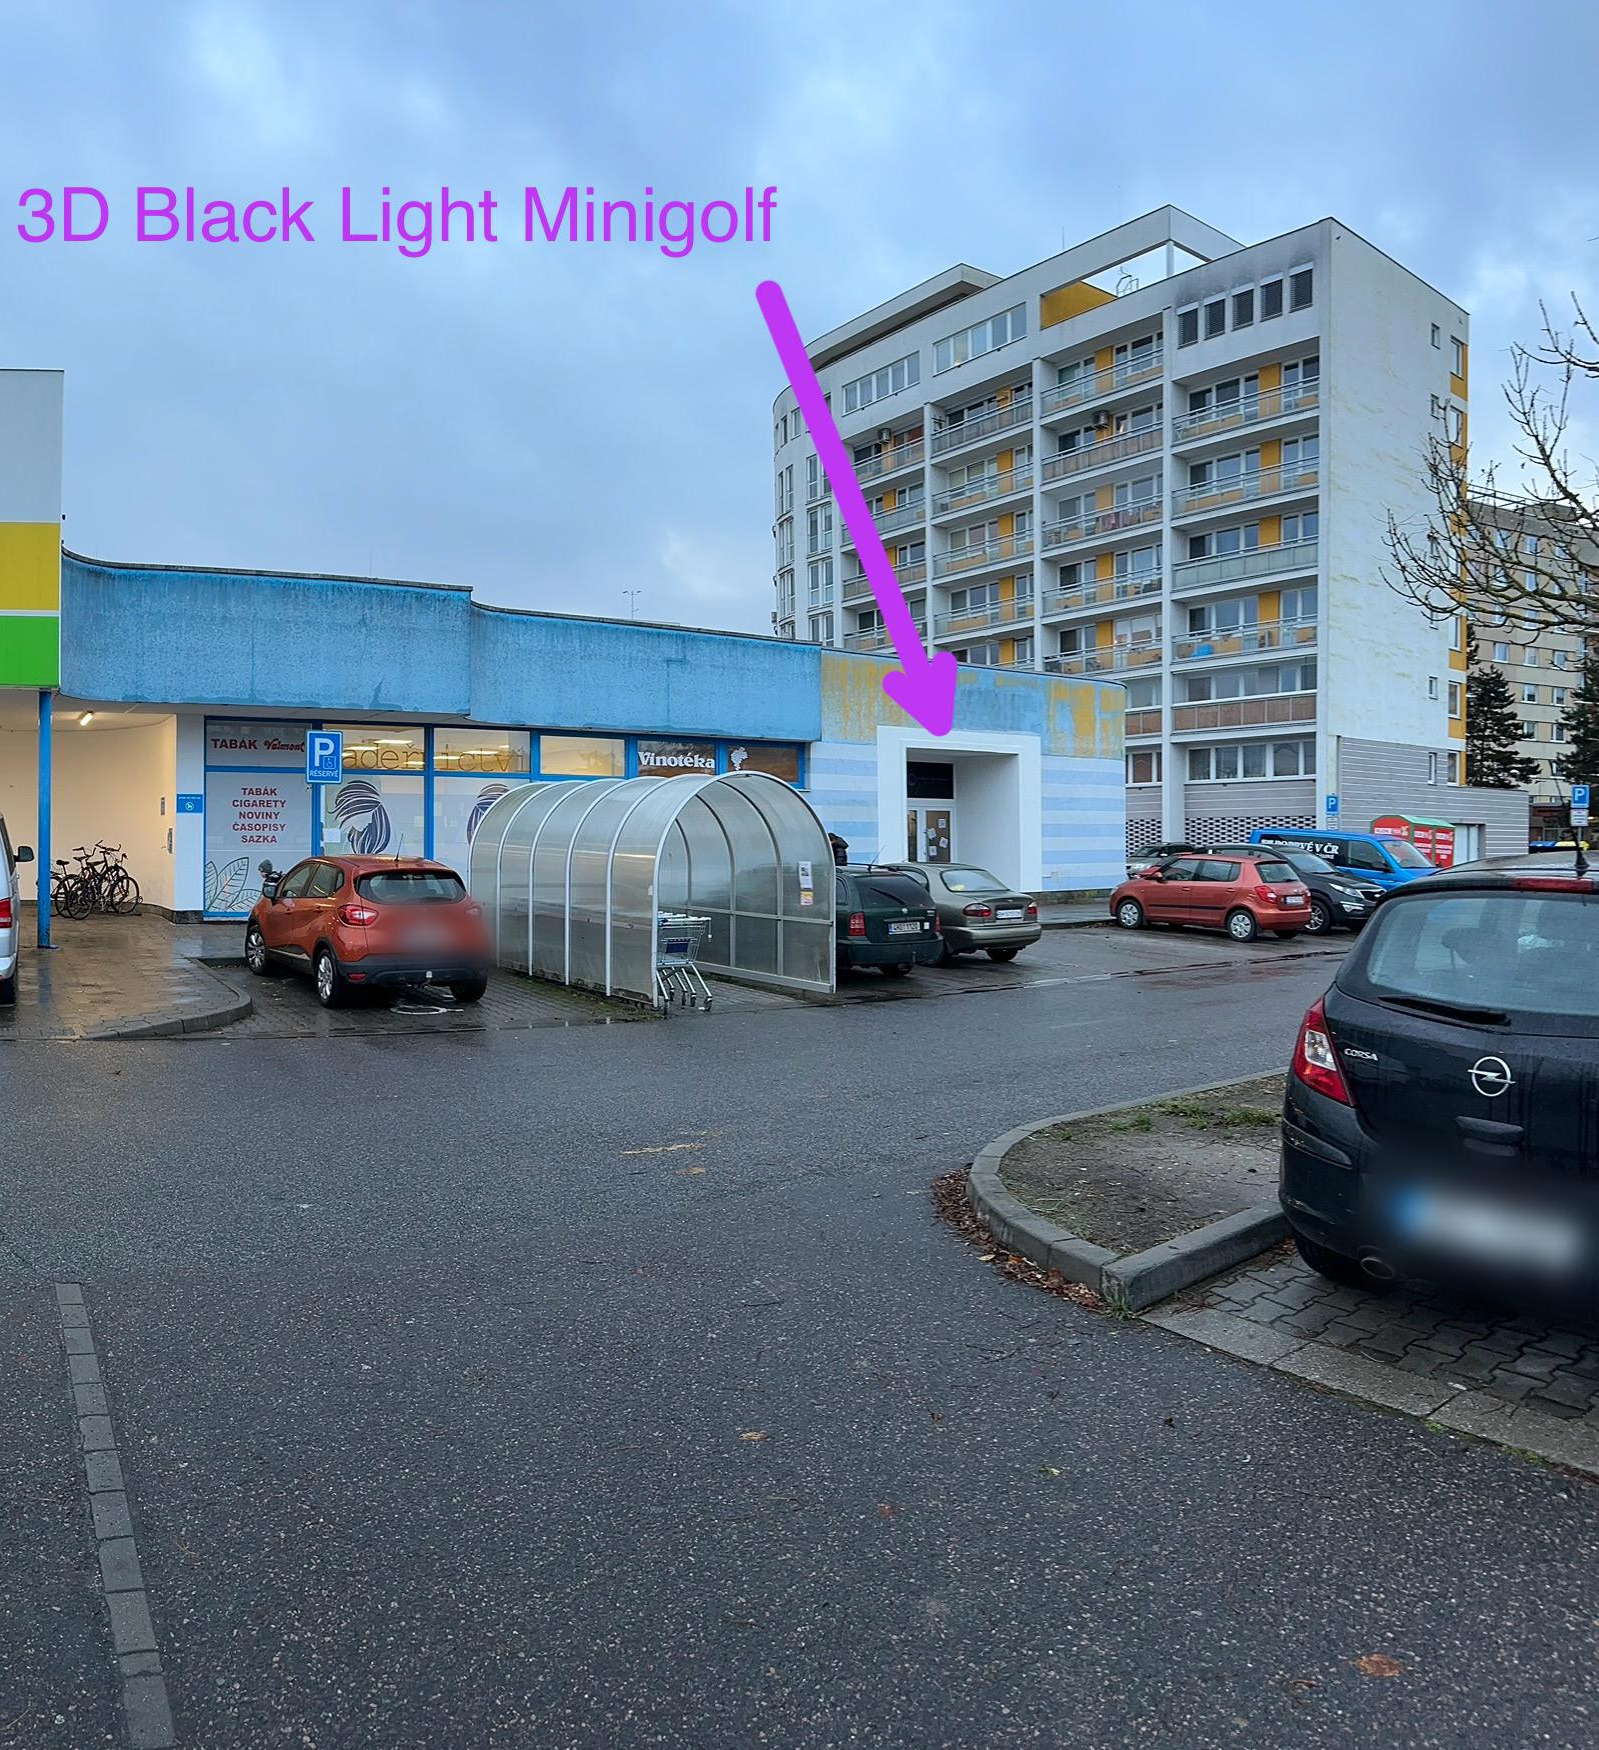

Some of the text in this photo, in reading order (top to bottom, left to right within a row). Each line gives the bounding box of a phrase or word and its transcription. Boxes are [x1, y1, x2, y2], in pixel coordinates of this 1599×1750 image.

[211, 737, 306, 753] TABÁK Valmont
[314, 737, 335, 767] P
[638, 752, 715, 769] Vinotéka
[242, 786, 278, 796] TABÁK
[1575, 788, 1585, 801] P
[232, 799, 287, 808] CIGARETY
[1328, 797, 1337, 809] P
[238, 811, 281, 820] NOVINY
[232, 822, 286, 832] ČASOPISY
[241, 834, 278, 844] SAZKA
[1344, 1048, 1378, 1061] CORSA
